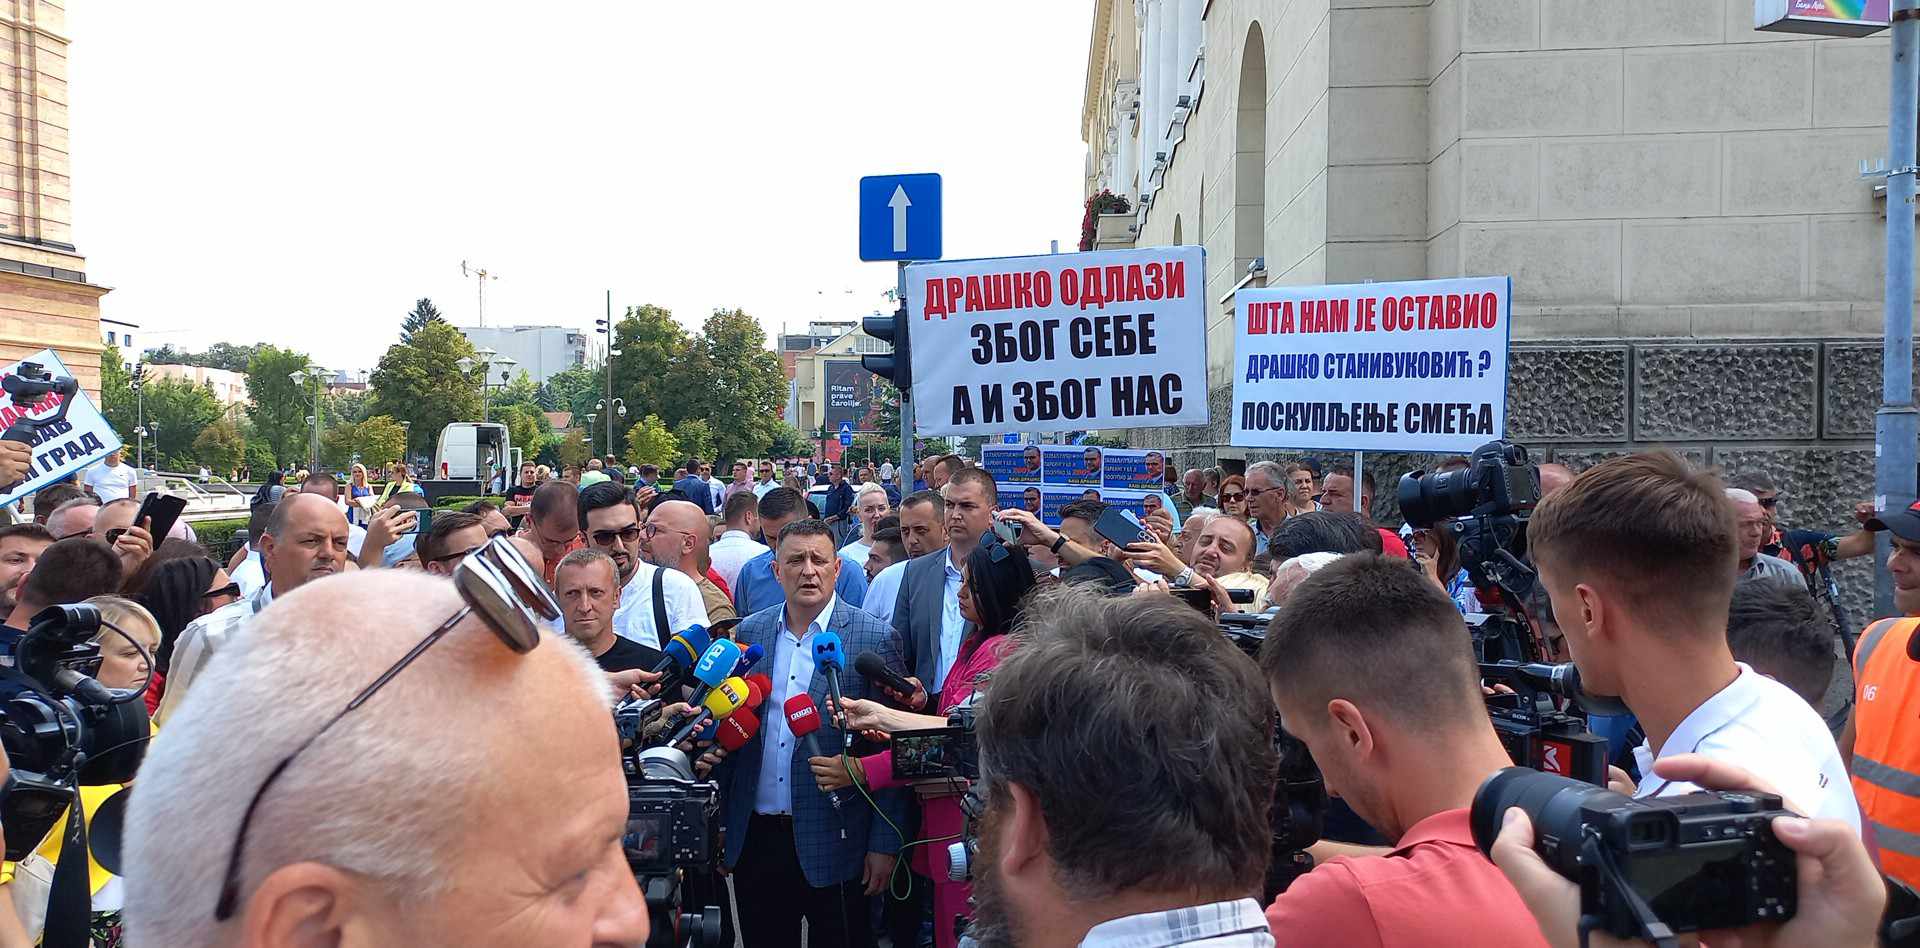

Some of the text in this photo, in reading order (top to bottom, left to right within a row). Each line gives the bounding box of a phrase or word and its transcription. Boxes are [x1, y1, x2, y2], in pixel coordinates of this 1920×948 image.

[924, 262, 1185, 320] ДРАШКО ОДЛАЗИ
[1247, 292, 1498, 334] ШТА НАМ ЈЕ ОСТАВИО
[970, 313, 1157, 365] ЗБОГ СЕБЕ
[1246, 350, 1492, 383] ДРАШКО СТАНИВУКОВИЋ ?
[951, 373, 1183, 425] А И ЗБОГ НАС
[1241, 402, 1494, 434] ПОСКУПЉЕЊЕ СМЕЋА
[36, 432, 105, 473] ГРАД
